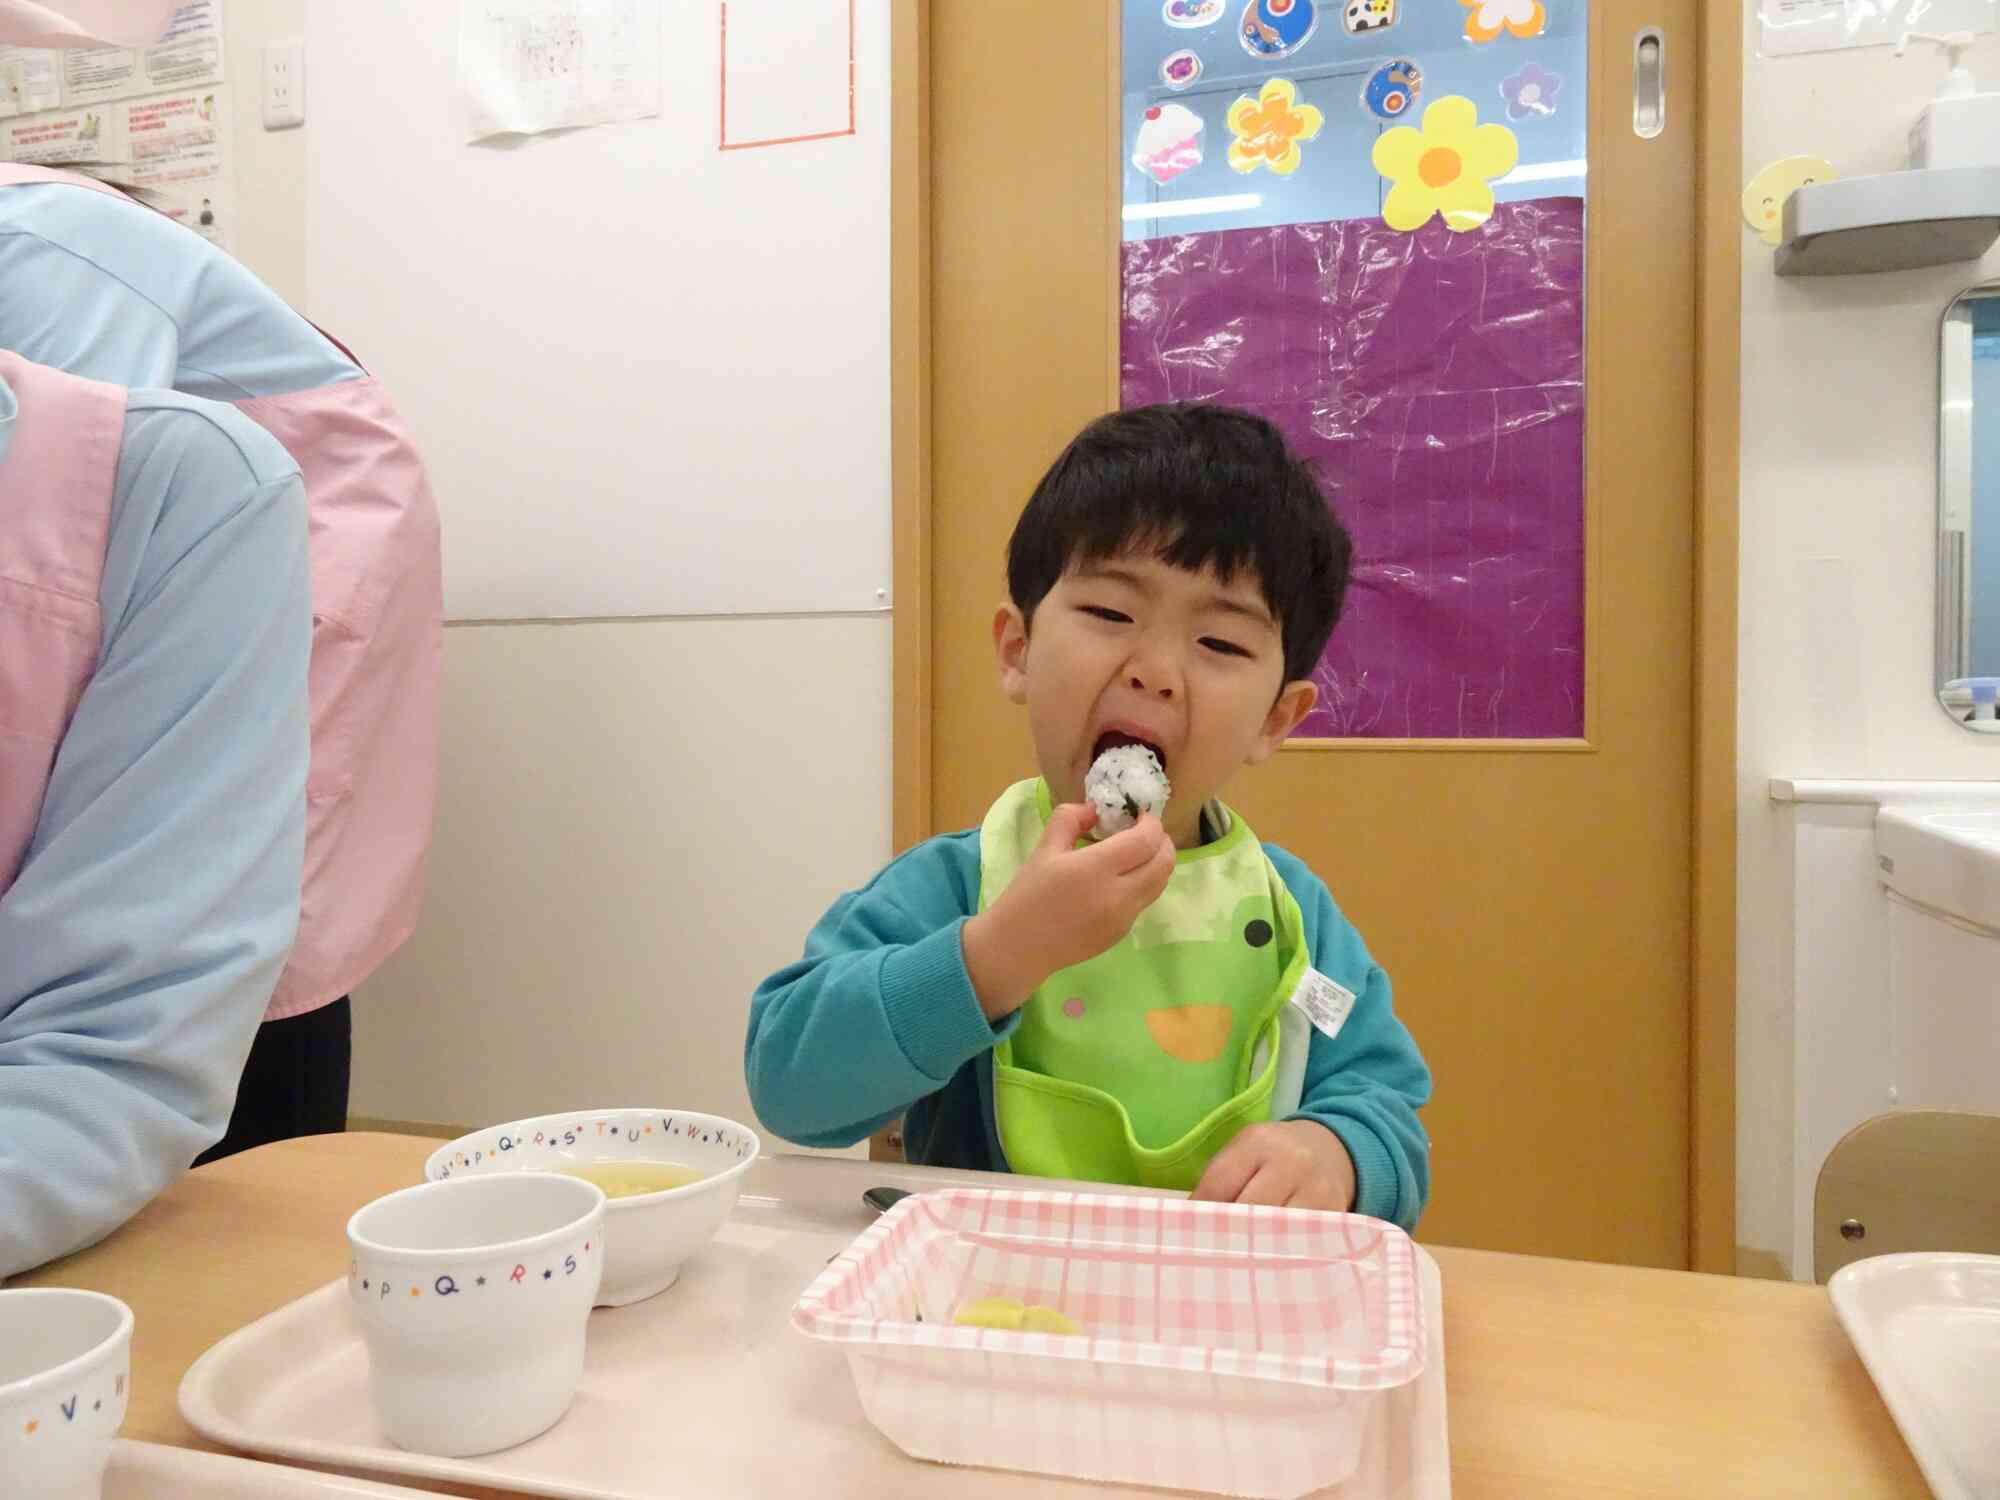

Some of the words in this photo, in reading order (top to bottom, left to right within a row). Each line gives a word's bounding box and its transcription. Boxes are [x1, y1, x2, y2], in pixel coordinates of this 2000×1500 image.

[499, 1136, 514, 1151] Q
[533, 1131, 544, 1145] R
[564, 1131, 576, 1145] S
[595, 1121, 606, 1136] T
[628, 1129, 640, 1143] U
[663, 1117, 673, 1132] V
[687, 1123, 701, 1139] W
[715, 1129, 724, 1144] X
[435, 1275, 460, 1295] Q
[510, 1263, 526, 1284] R
[565, 1254, 577, 1275] S
[61, 1394, 76, 1421] V
